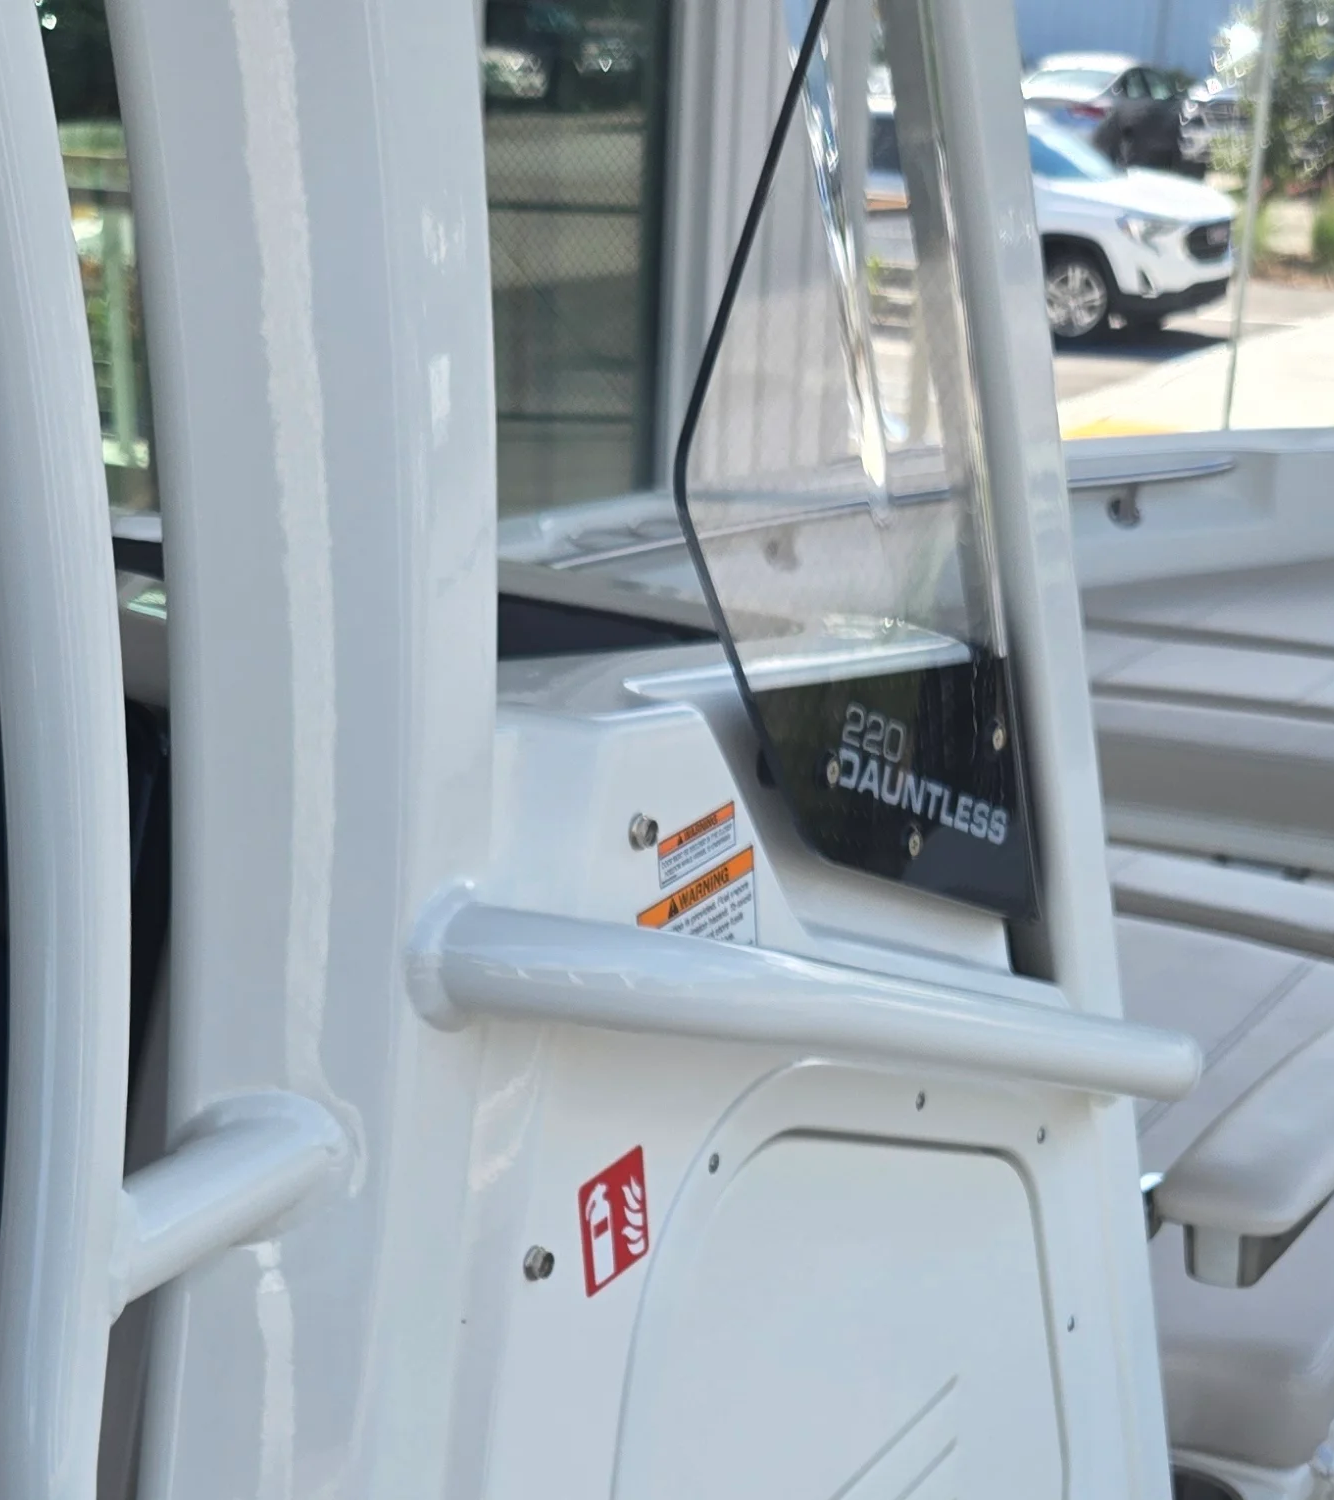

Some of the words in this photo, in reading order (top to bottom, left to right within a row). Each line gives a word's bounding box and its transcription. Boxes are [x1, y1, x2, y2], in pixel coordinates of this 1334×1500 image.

[841, 703, 906, 763] 220
[838, 747, 1008, 846] DAUNTLESS
[678, 867, 729, 912] WARNING
